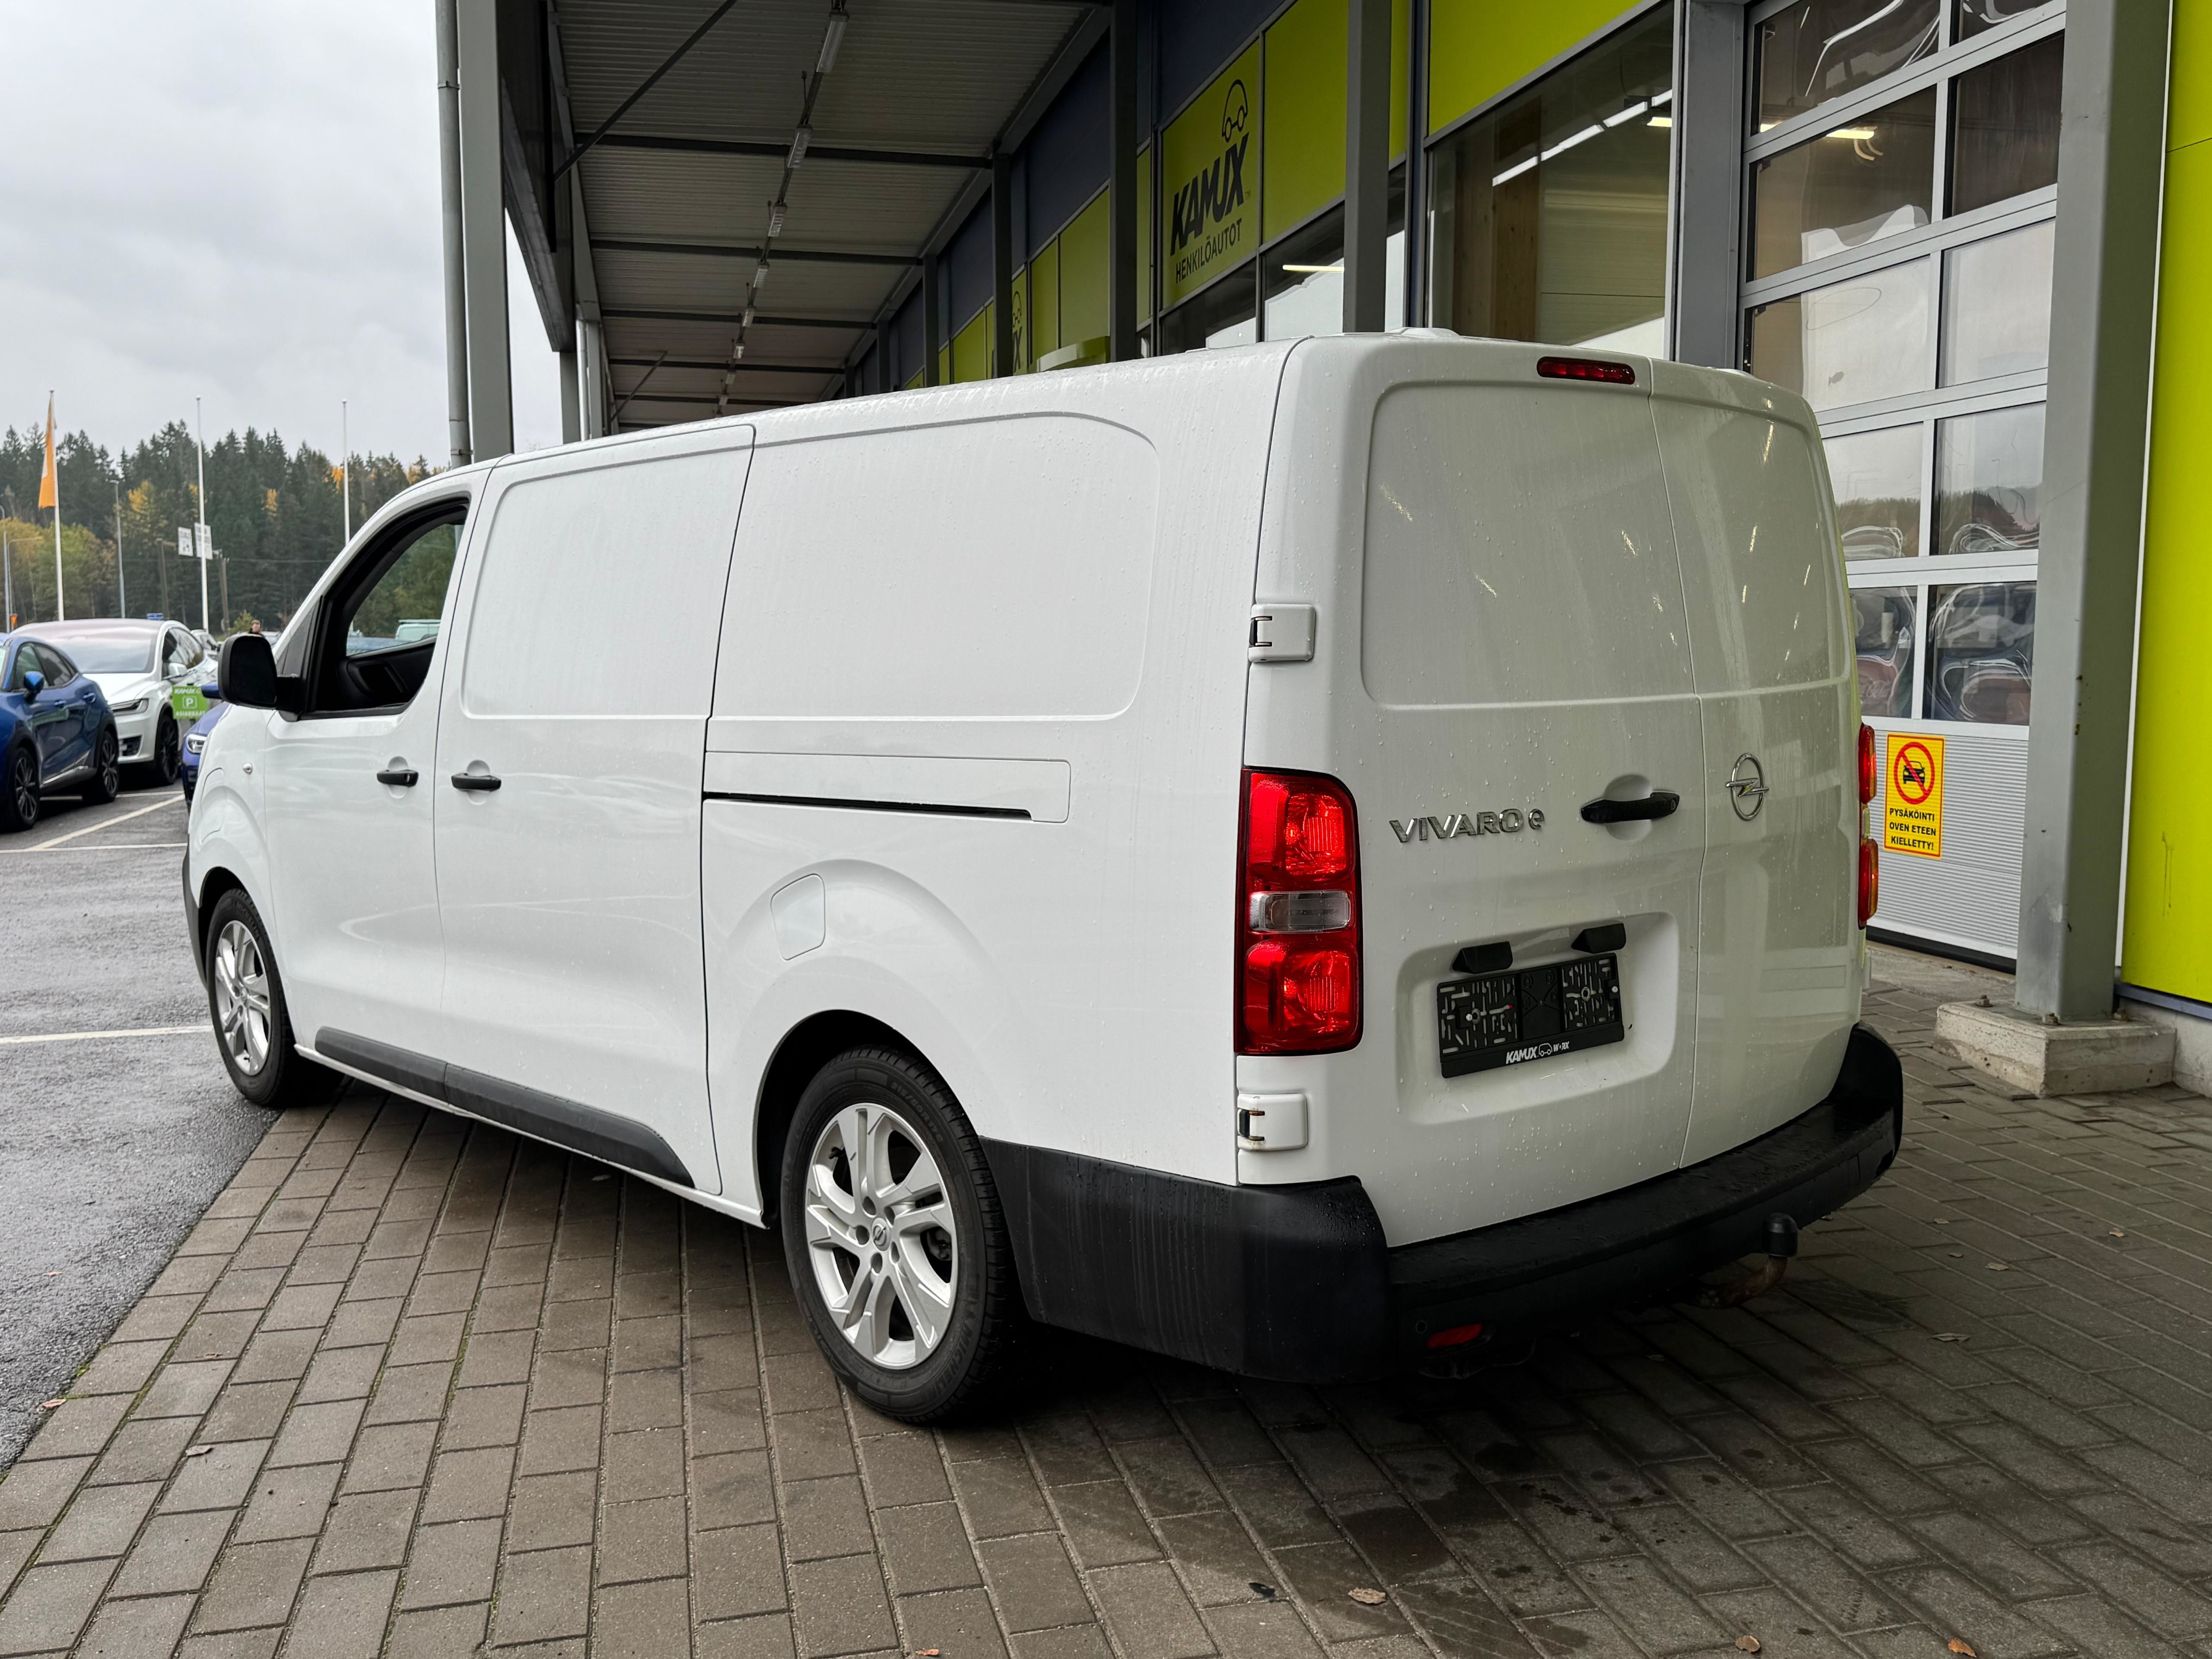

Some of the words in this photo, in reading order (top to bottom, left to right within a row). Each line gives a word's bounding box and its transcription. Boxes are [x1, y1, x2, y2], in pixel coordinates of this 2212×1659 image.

[1170, 132, 1249, 256] KAMUX
[1176, 218, 1242, 283] HENKILÖAUTOT
[186, 698, 194, 708] P
[1890, 807, 1935, 822] PYSÄKÖINTI
[1389, 808, 1524, 843] VIVARO
[1889, 822, 1909, 832] OVEN
[1911, 825, 1936, 836] ETEEN
[1891, 836, 1934, 851] KIELLETTY!
[1506, 1046, 1538, 1064] KAMUX
